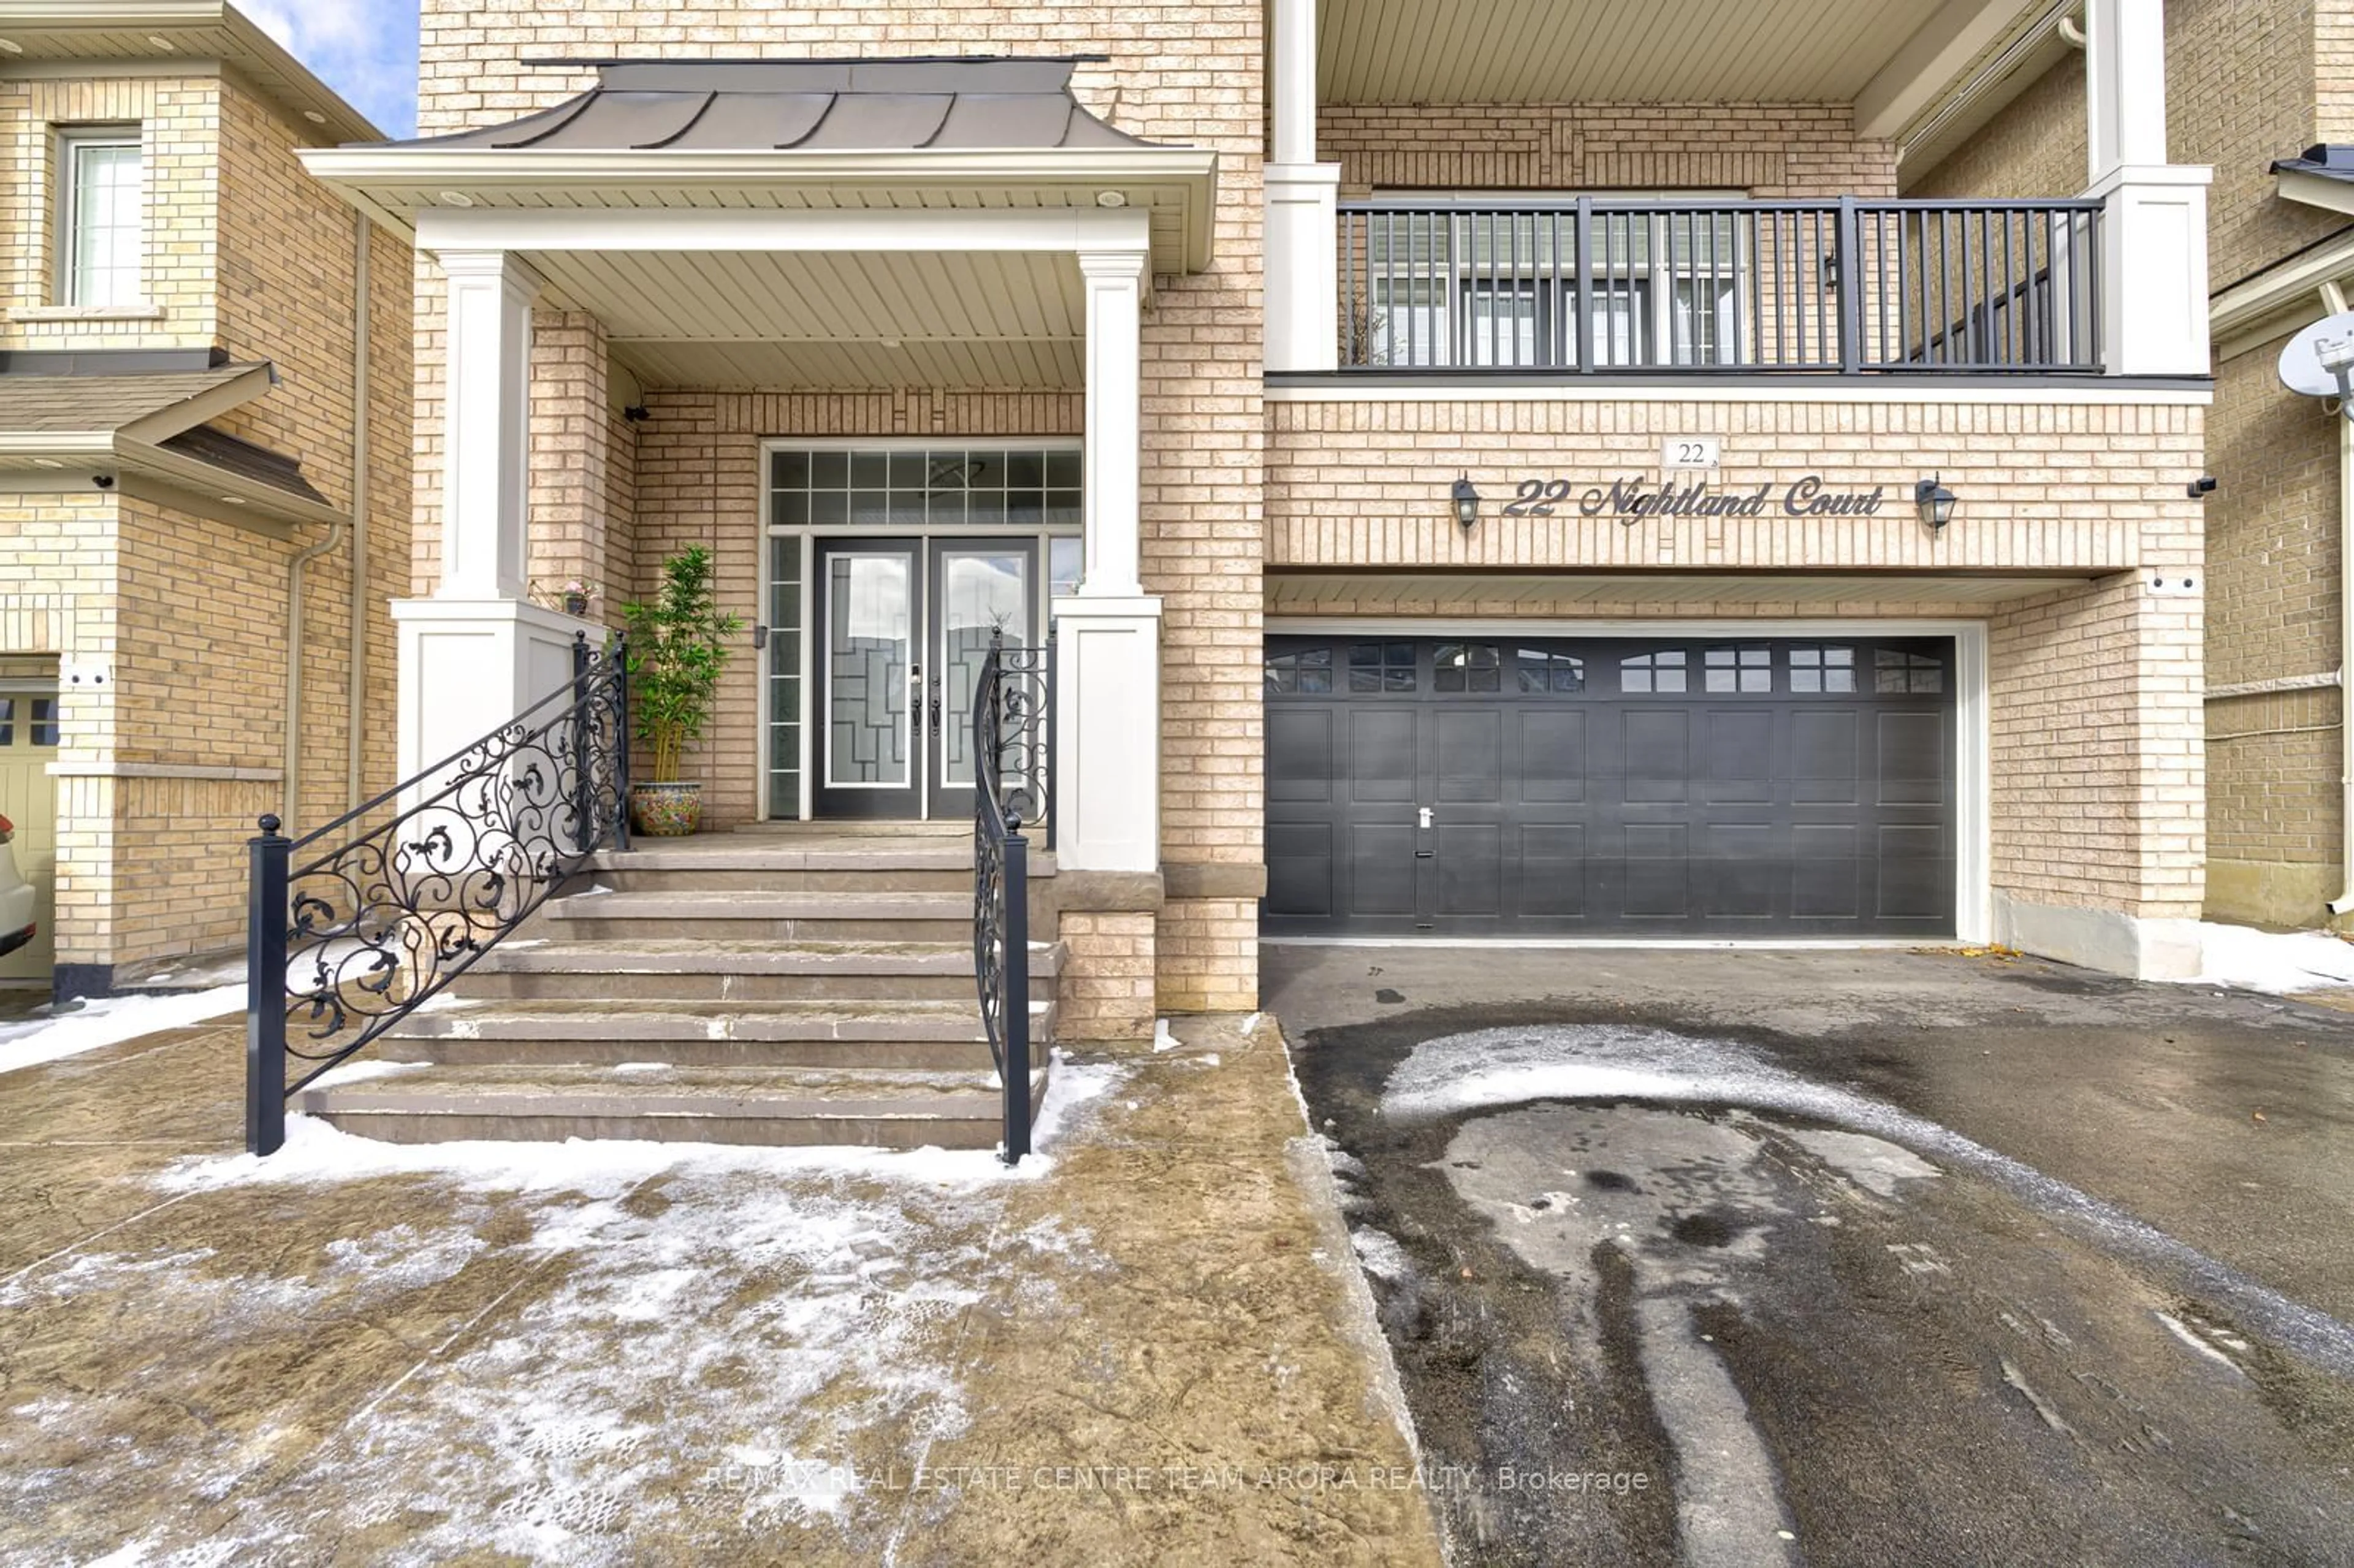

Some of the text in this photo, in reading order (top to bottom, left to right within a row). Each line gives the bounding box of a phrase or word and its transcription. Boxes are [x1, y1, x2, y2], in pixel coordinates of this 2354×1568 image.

[1679, 444, 1704, 463] 22
[1504, 475, 1883, 527] 22 Nightland Court
